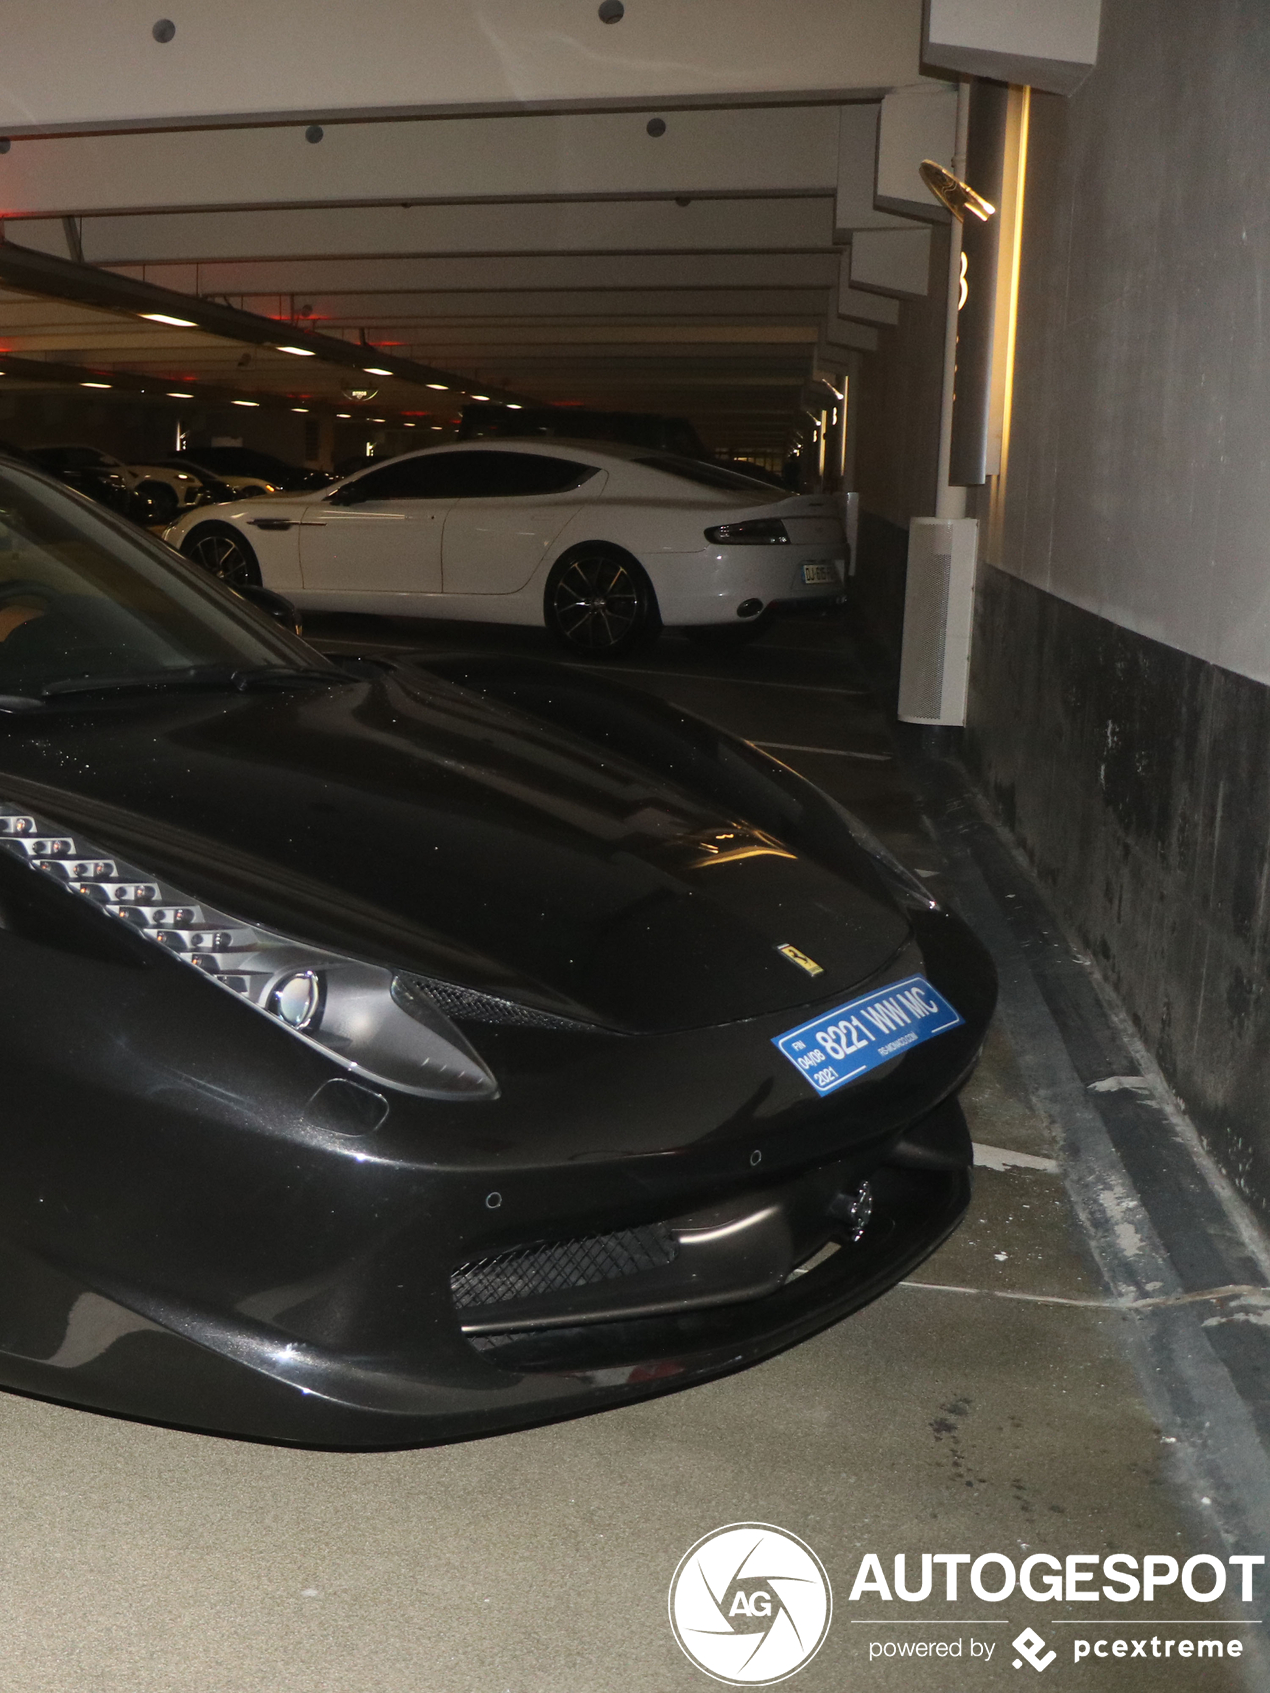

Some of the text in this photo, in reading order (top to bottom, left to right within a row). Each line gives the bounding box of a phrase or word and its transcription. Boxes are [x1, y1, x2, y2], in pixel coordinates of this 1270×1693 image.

[815, 986, 939, 1060] 8221 WW MC
[791, 1040, 806, 1051] FIN
[797, 1048, 826, 1070] 04/08
[813, 1065, 839, 1086] 2021
